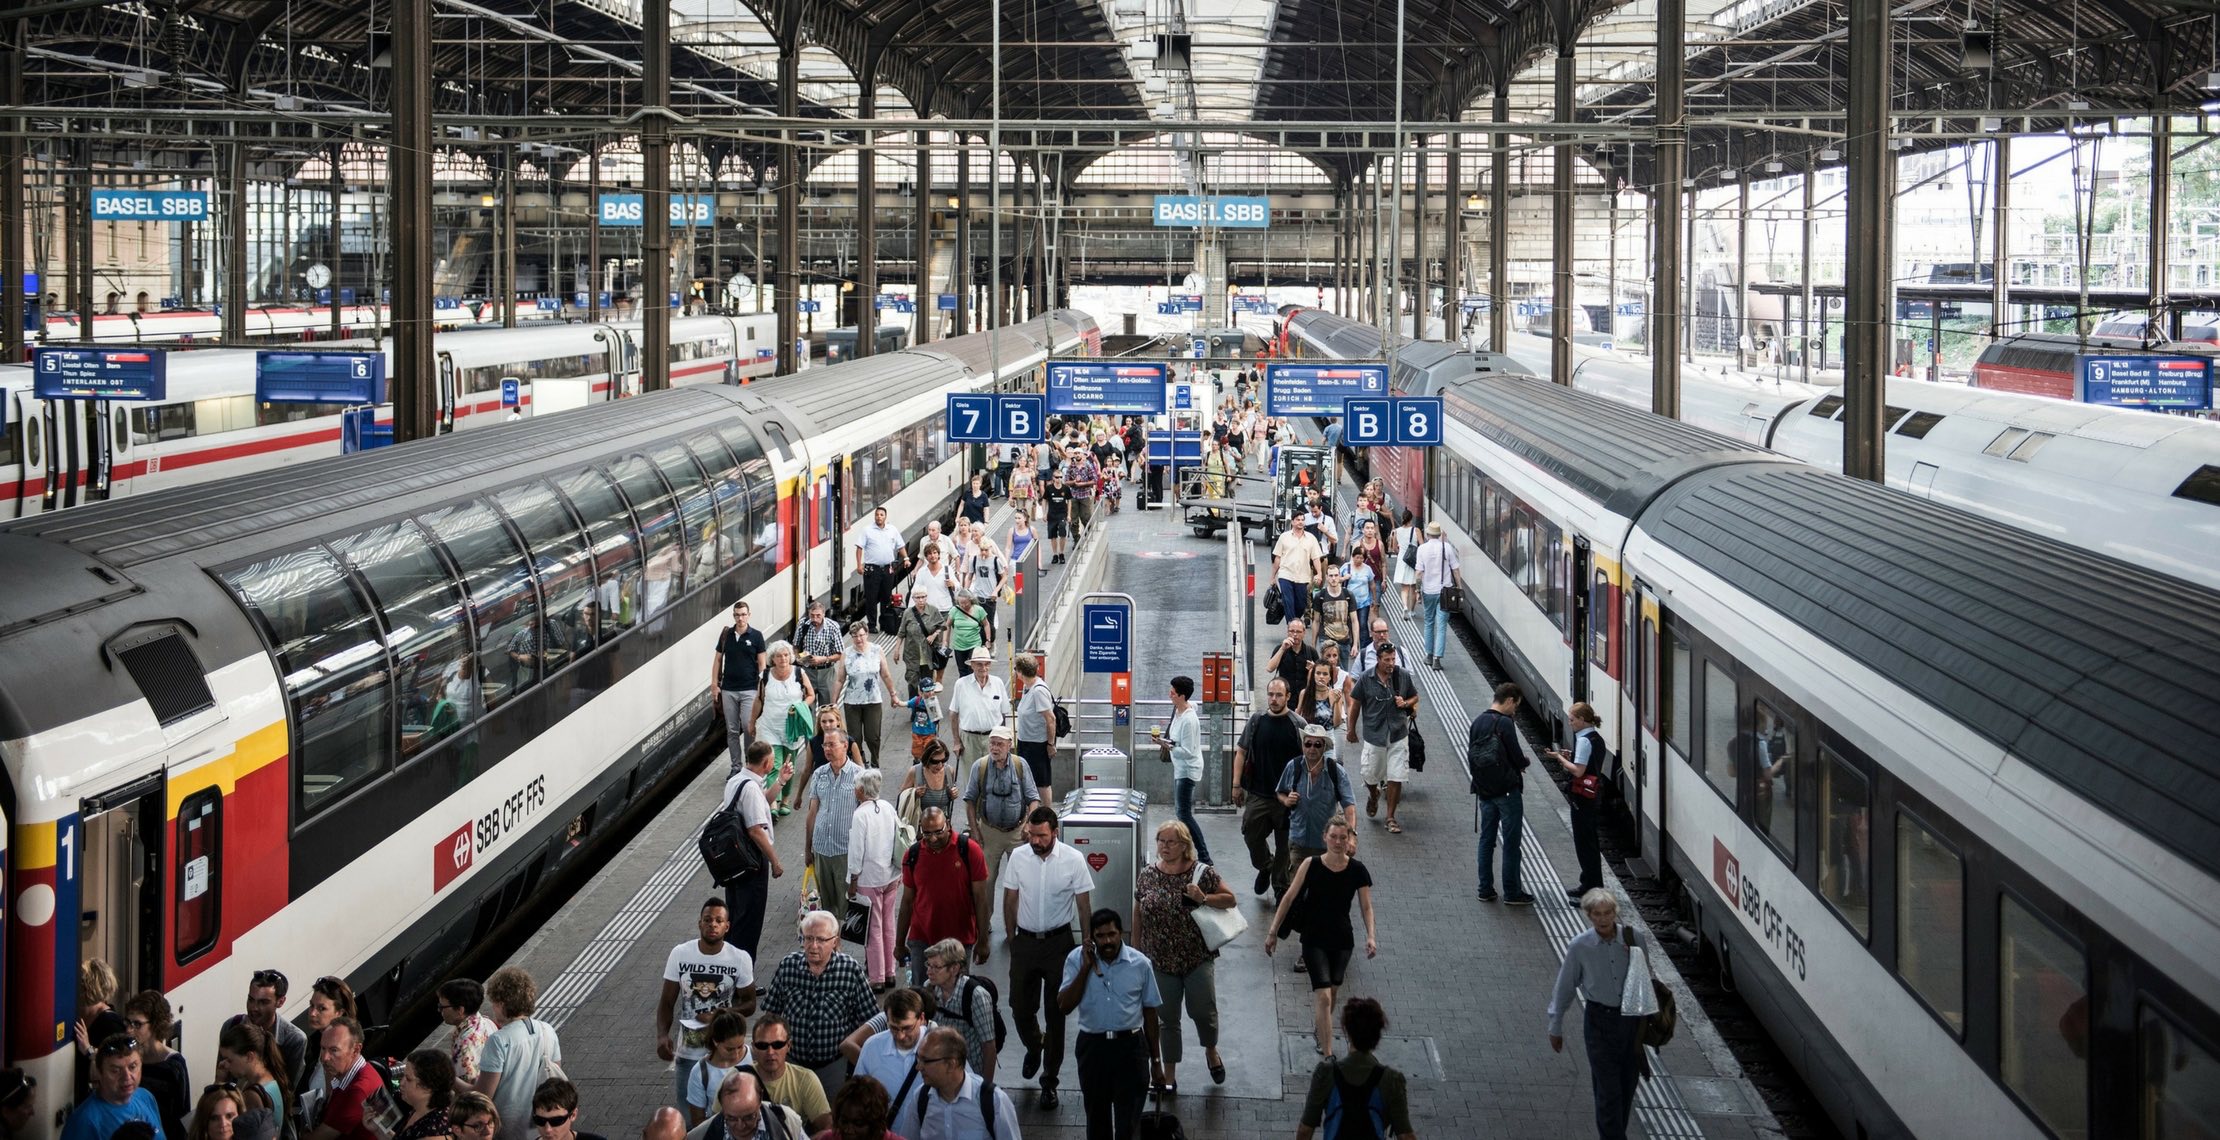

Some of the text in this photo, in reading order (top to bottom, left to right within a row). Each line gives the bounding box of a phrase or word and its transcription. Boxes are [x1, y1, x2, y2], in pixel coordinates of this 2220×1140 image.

[96, 197, 203, 215] BASEL SBB
[604, 203, 641, 220] BAS
[1160, 203, 1264, 221] BASEL SBB
[46, 359, 56, 371] 5
[357, 364, 366, 377] 6
[2094, 367, 2105, 380] 9
[1057, 374, 1067, 386] 7
[1368, 377, 1377, 389] 8
[2158, 379, 2187, 387] Hamburg
[1273, 387, 1291, 395] Brugg
[962, 410, 980, 434] 7
[1011, 411, 1030, 435] B
[1359, 413, 1378, 437] B
[1409, 413, 1428, 437] 8
[476, 773, 545, 854] SBB CFF FFS
[61, 825, 74, 881] 1
[1742, 875, 1806, 982] SBB CFF FFS
[678, 963, 737, 975] WILD STRIP
